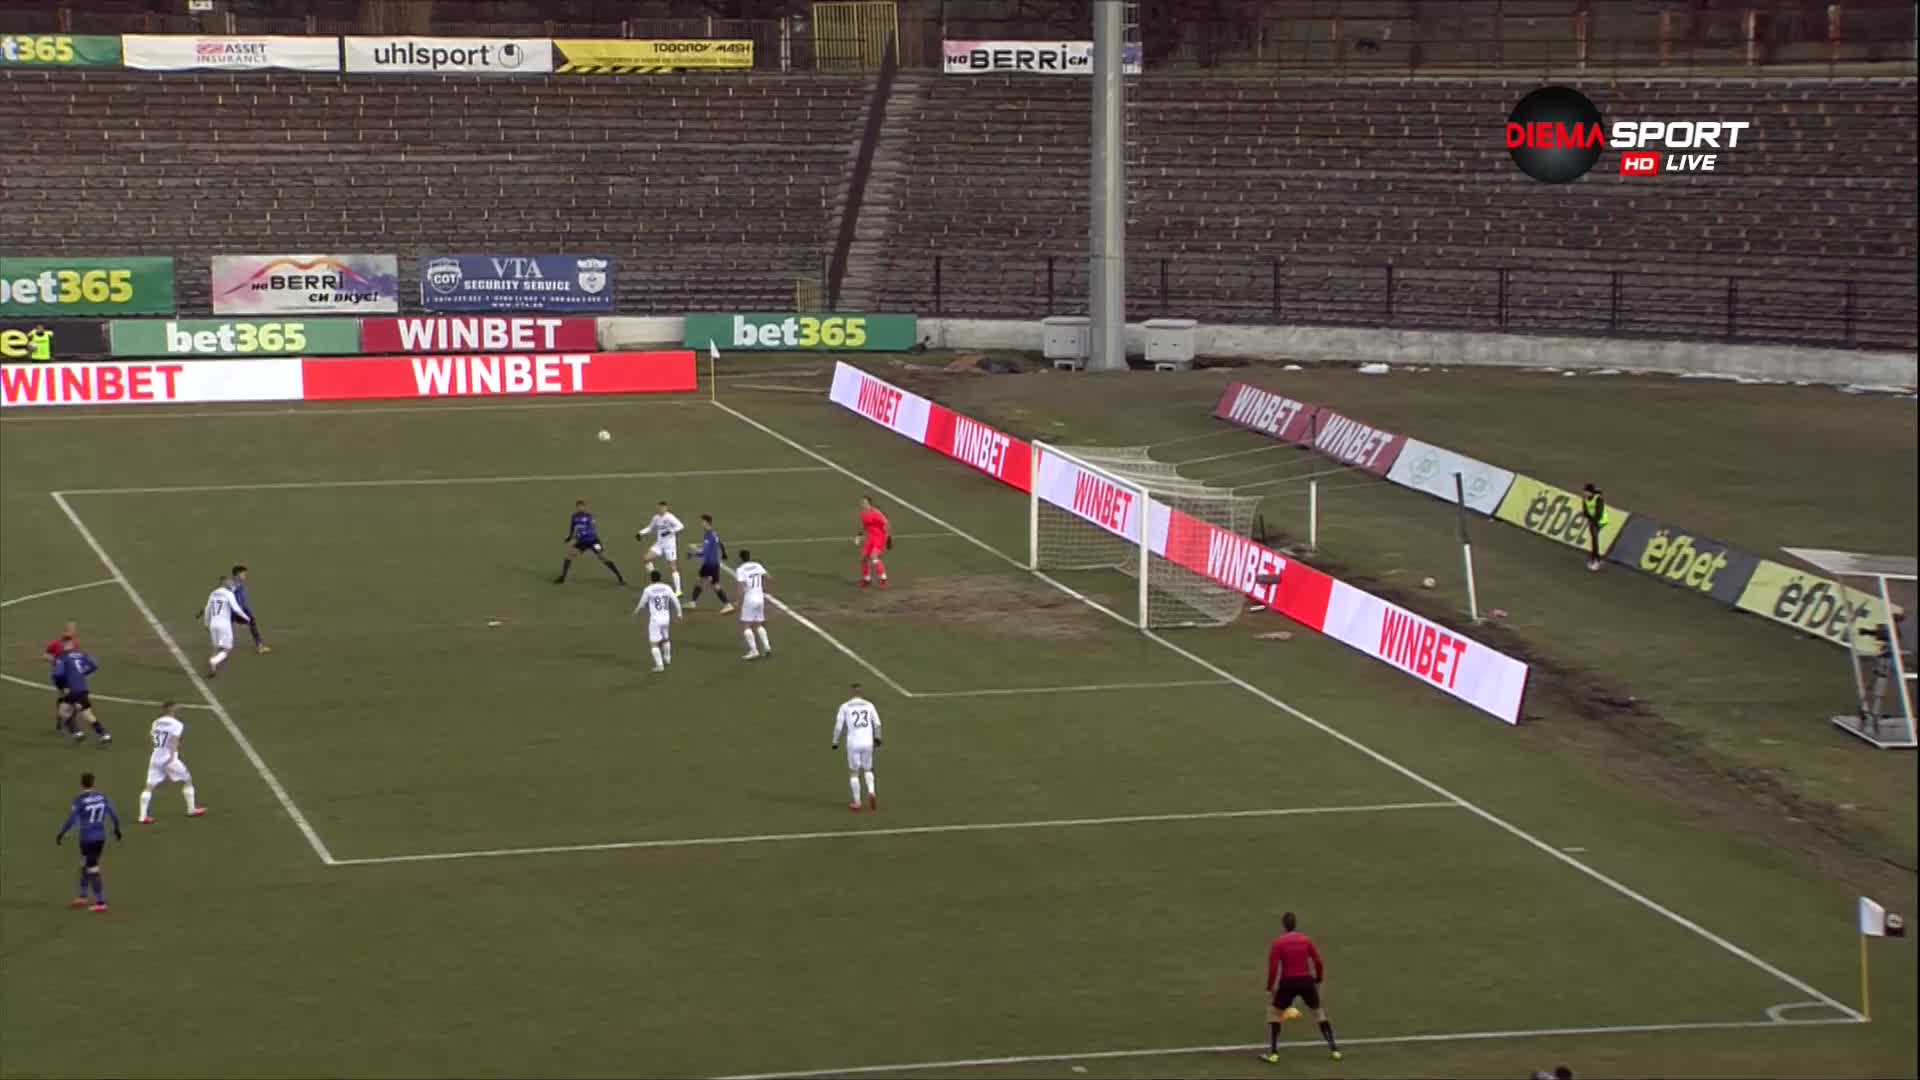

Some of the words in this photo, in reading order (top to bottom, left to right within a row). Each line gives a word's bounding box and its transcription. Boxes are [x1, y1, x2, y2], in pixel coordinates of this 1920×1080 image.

[197, 55, 267, 63] INSURANCE
[225, 44, 267, 54] ASSET
[374, 43, 490, 69] uhlsport
[463, 279, 520, 291] SECURITY
[523, 279, 571, 291] SERVICE
[491, 258, 544, 279] VTA
[166, 323, 306, 352] bet365
[398, 318, 563, 350] WINBET
[733, 315, 866, 347] bet365
[1, 365, 183, 403] WINBET
[412, 355, 591, 395] WINBET
[858, 376, 902, 426] WINBET
[1229, 384, 1303, 435] WINBET
[952, 416, 1010, 477] WINBET
[1315, 413, 1393, 466] WINBET
[1073, 470, 1133, 533] WINBET
[1207, 528, 1287, 604] WINBET
[1640, 529, 1728, 592] ëfbet
[1379, 607, 1467, 689] WINBET
[851, 708, 869, 728] 23
[85, 803, 105, 823] 77
